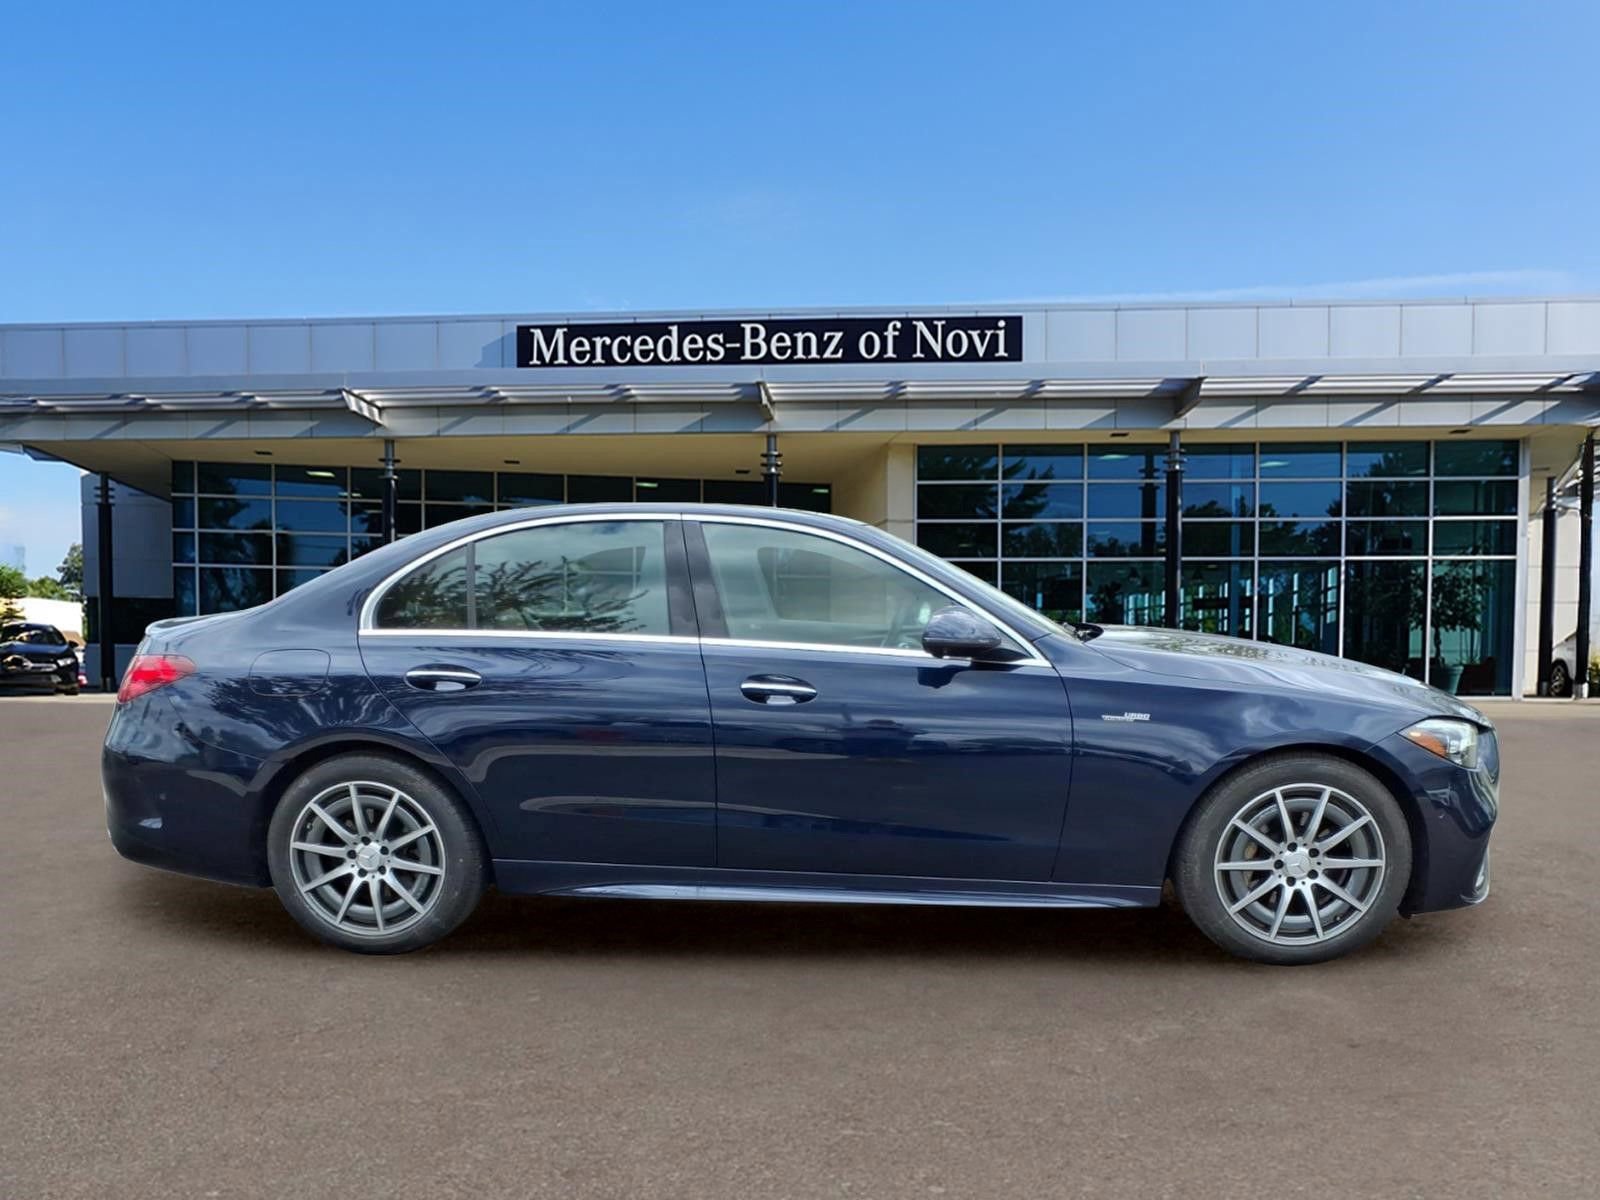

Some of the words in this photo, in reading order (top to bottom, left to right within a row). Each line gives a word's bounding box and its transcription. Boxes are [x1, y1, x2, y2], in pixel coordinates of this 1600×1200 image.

[529, 323, 844, 365] Mercedes-Benz
[858, 320, 902, 359] of
[911, 319, 1009, 359] Novi
